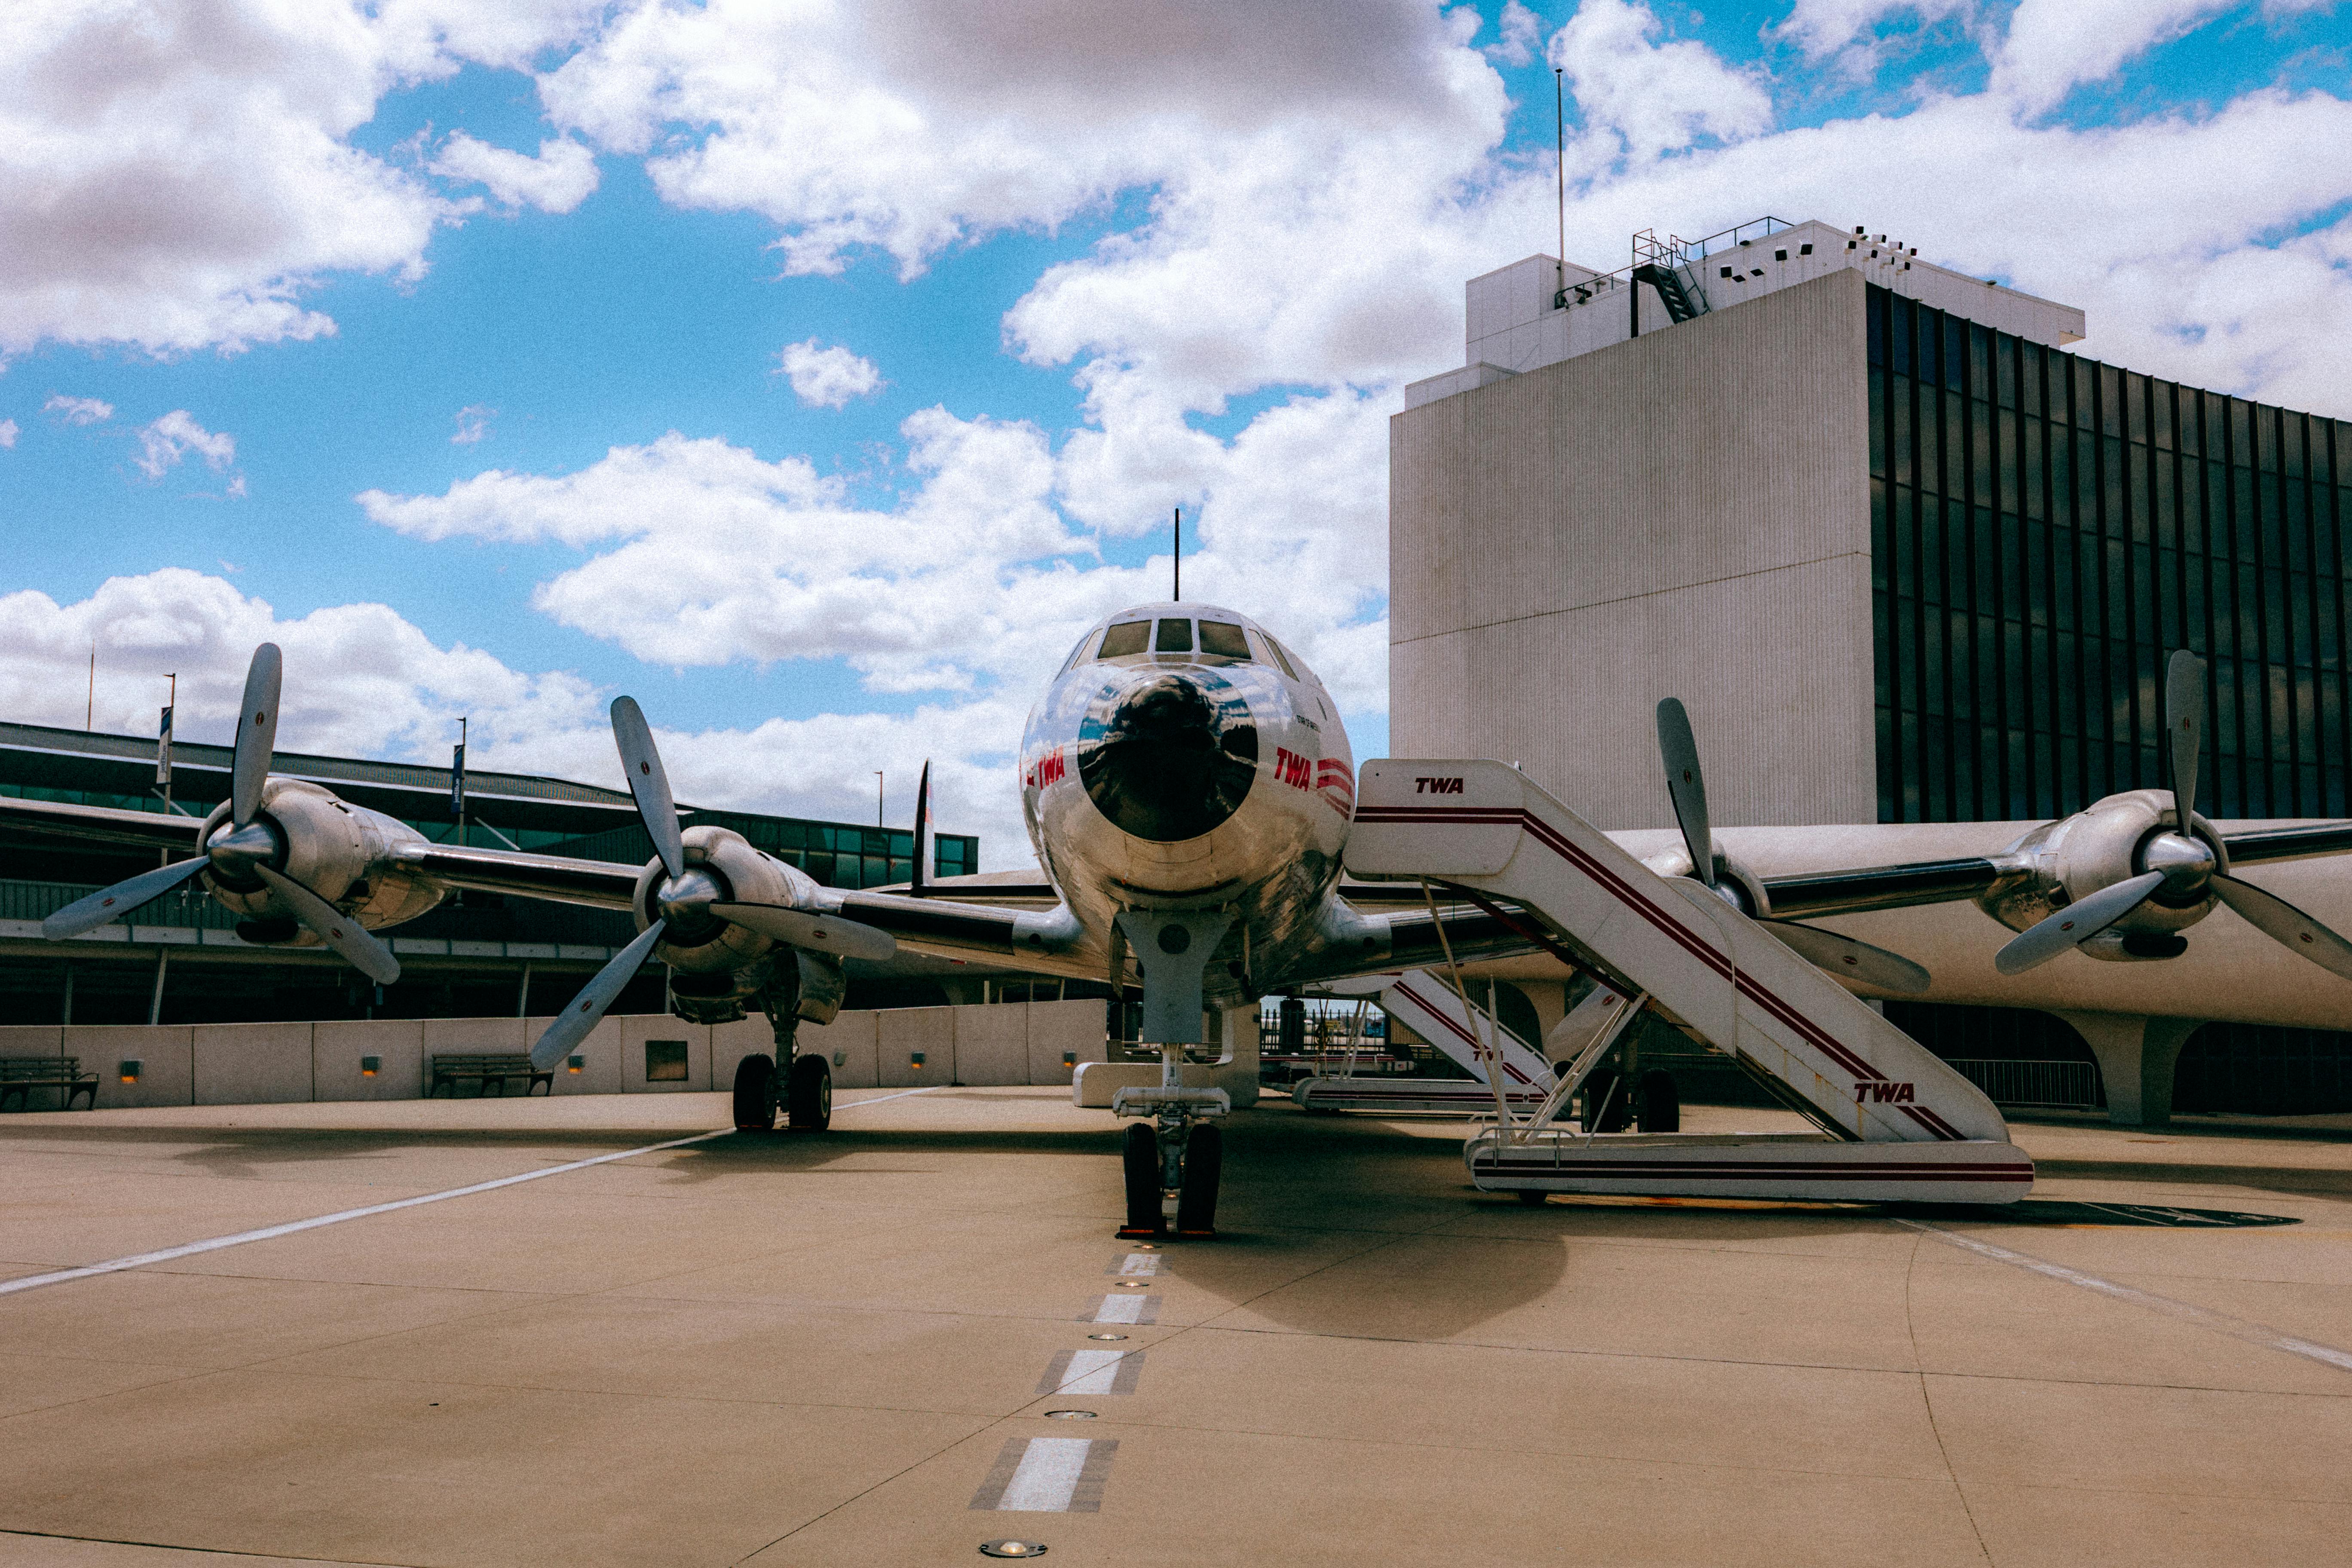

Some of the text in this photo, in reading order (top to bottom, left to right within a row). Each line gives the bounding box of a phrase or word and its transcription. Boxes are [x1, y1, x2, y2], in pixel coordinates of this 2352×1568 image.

[1296, 715, 1306, 725] STAR
[1310, 721, 1321, 733] AMER
[1038, 744, 1065, 790] TWA
[1274, 747, 1311, 792] TWA
[1415, 778, 1464, 793] TWA
[1854, 1083, 1914, 1102] TWA
